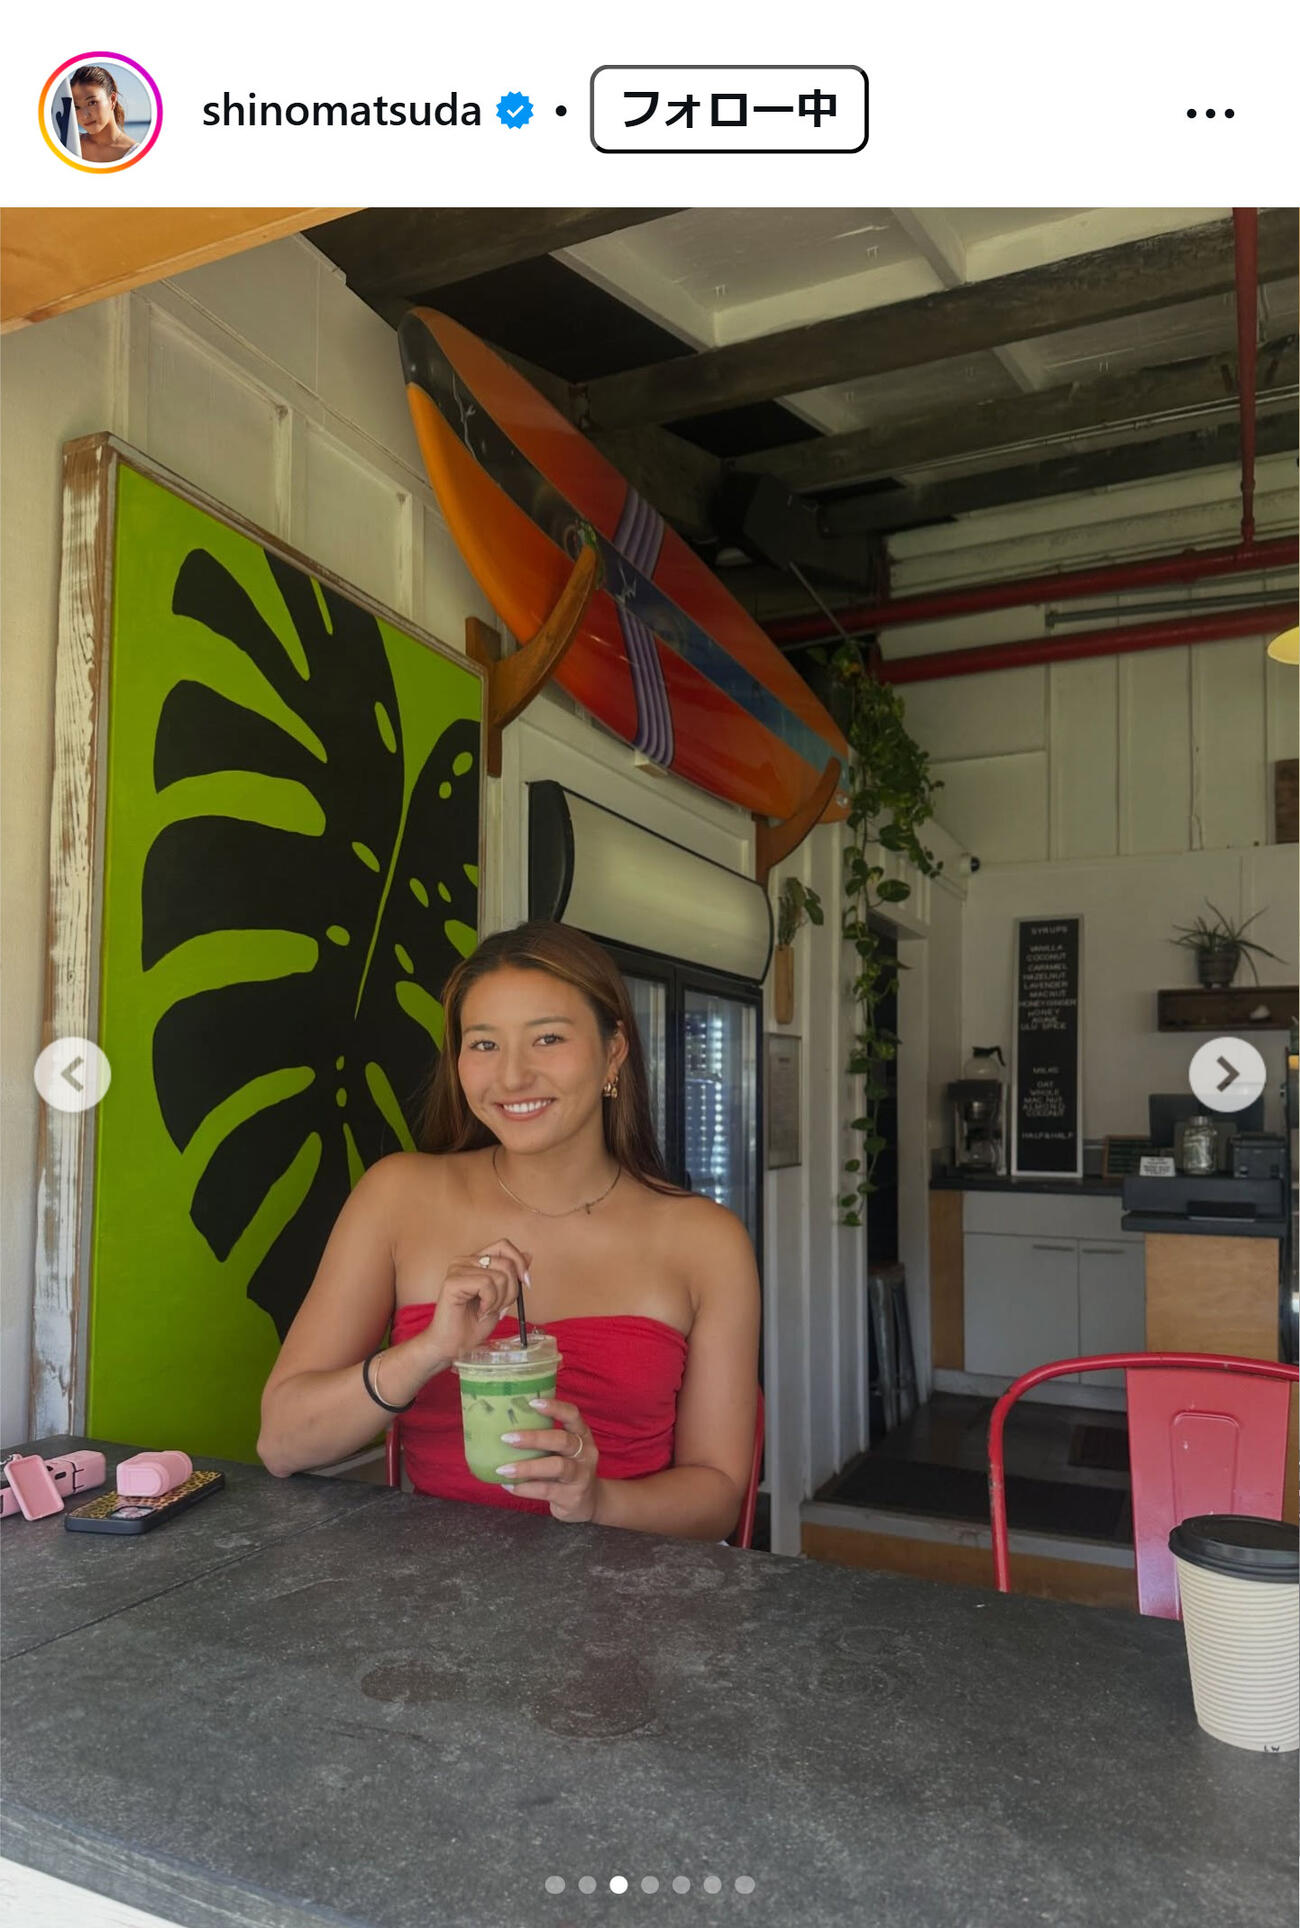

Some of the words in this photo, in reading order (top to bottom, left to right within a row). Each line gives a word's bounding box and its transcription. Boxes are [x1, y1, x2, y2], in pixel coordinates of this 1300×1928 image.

[1025, 952, 1066, 962] COCONUT
[1027, 963, 1068, 971] CARAMEL
[1022, 971, 1066, 980] HAZELNUT
[1023, 981, 1068, 990] LAVENDER
[1028, 1008, 1060, 1017] HONEY
